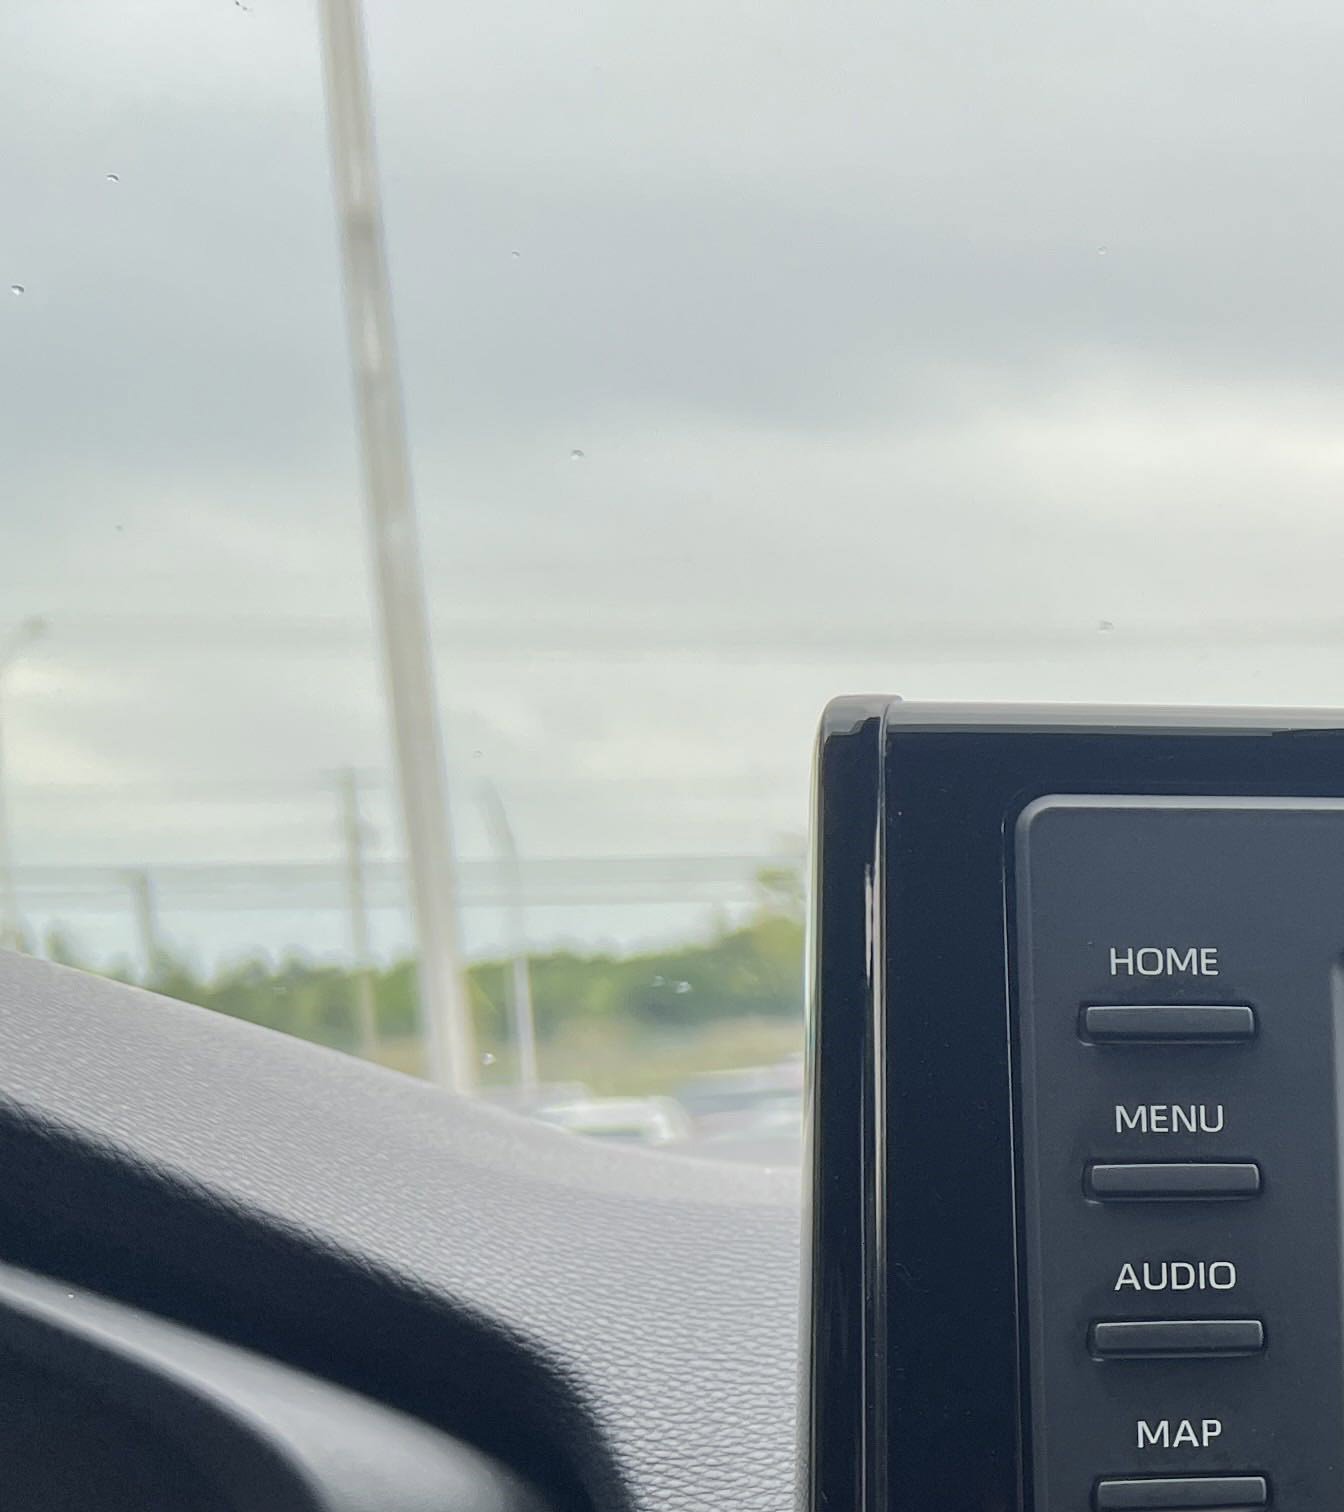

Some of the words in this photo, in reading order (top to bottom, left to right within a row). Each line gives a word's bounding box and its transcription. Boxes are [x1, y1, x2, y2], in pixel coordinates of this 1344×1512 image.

[1109, 947, 1219, 976] HOME
[1114, 1105, 1225, 1133] MENU
[1114, 1262, 1237, 1291] AUDIO
[1136, 1420, 1222, 1448] MAP
